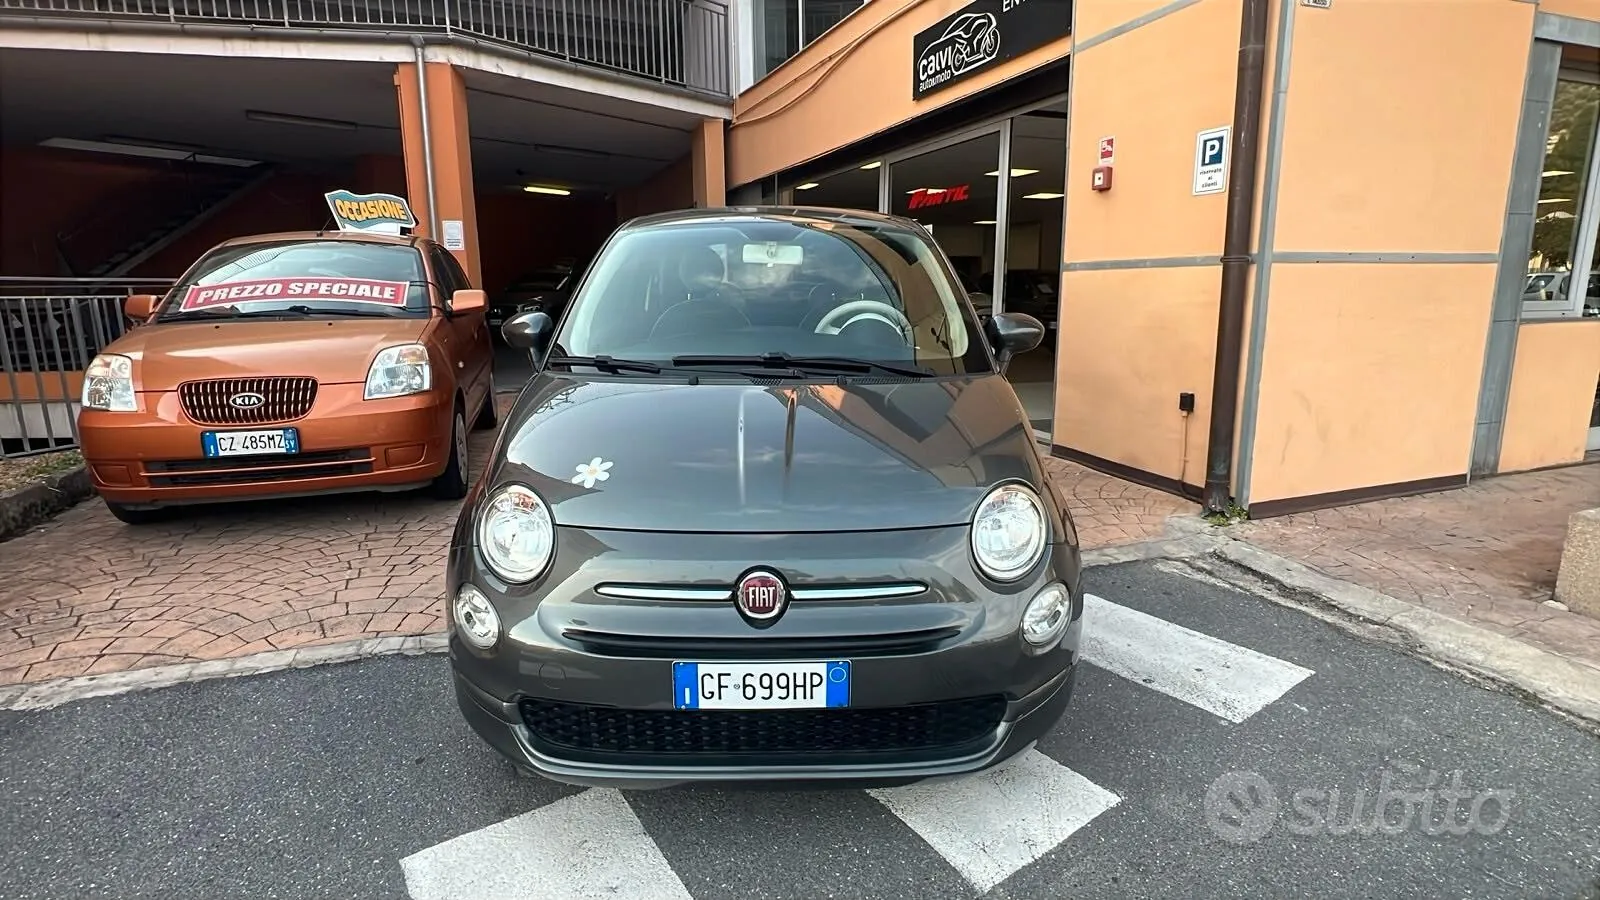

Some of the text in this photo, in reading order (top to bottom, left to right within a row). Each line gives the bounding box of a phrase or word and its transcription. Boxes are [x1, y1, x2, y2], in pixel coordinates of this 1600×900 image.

[1204, 139, 1220, 164] P
[335, 199, 408, 221] OCCASIONE
[197, 282, 396, 304] PREZZO SPECIALE
[235, 396, 259, 405] KIA
[218, 434, 285, 451] CZ 485MZ
[748, 586, 776, 608] FIAT
[701, 672, 824, 700] GF 699HP
